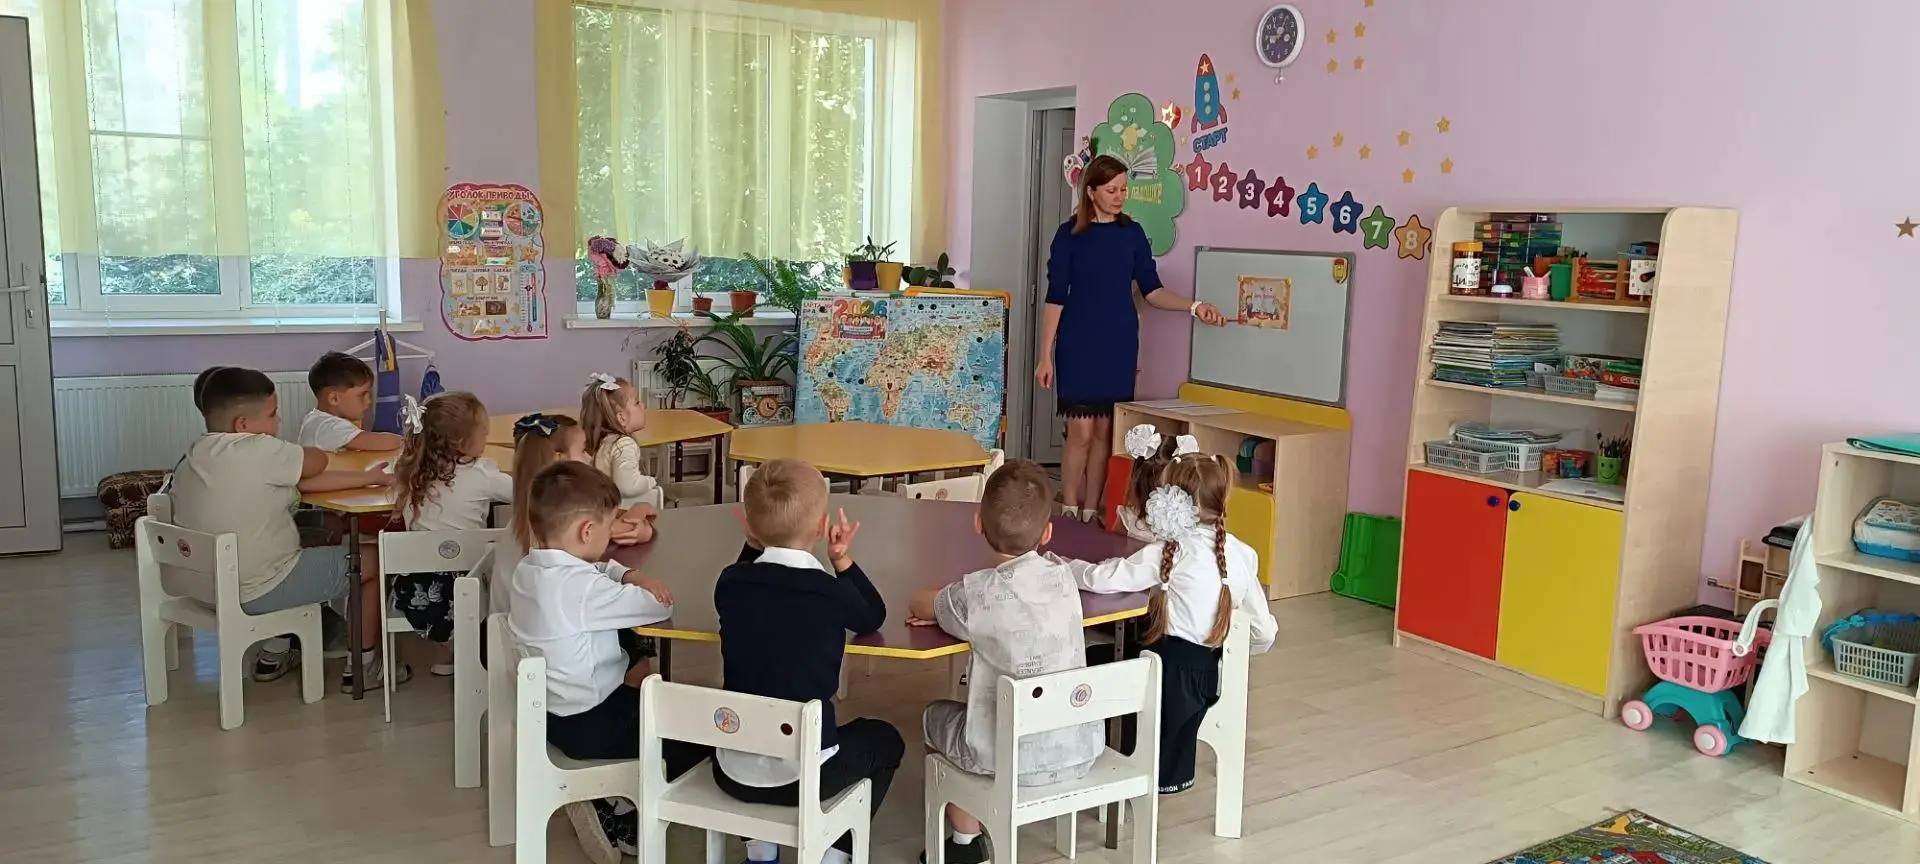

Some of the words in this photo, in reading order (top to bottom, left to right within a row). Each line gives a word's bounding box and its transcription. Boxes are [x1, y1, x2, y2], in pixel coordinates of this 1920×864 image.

[1193, 127, 1228, 153] СТАРТ
[1194, 166, 1202, 182] 1
[1218, 176, 1228, 193] 2
[1244, 183, 1255, 200] 3
[448, 190, 483, 200] УГОЛОК
[486, 190, 531, 200] ПРИРОДЫ
[1273, 190, 1285, 208] 4
[1306, 197, 1317, 215] 5
[1340, 205, 1352, 224] 6
[1371, 221, 1383, 240] 7
[1405, 230, 1418, 249] 8
[833, 300, 888, 316] 2026
